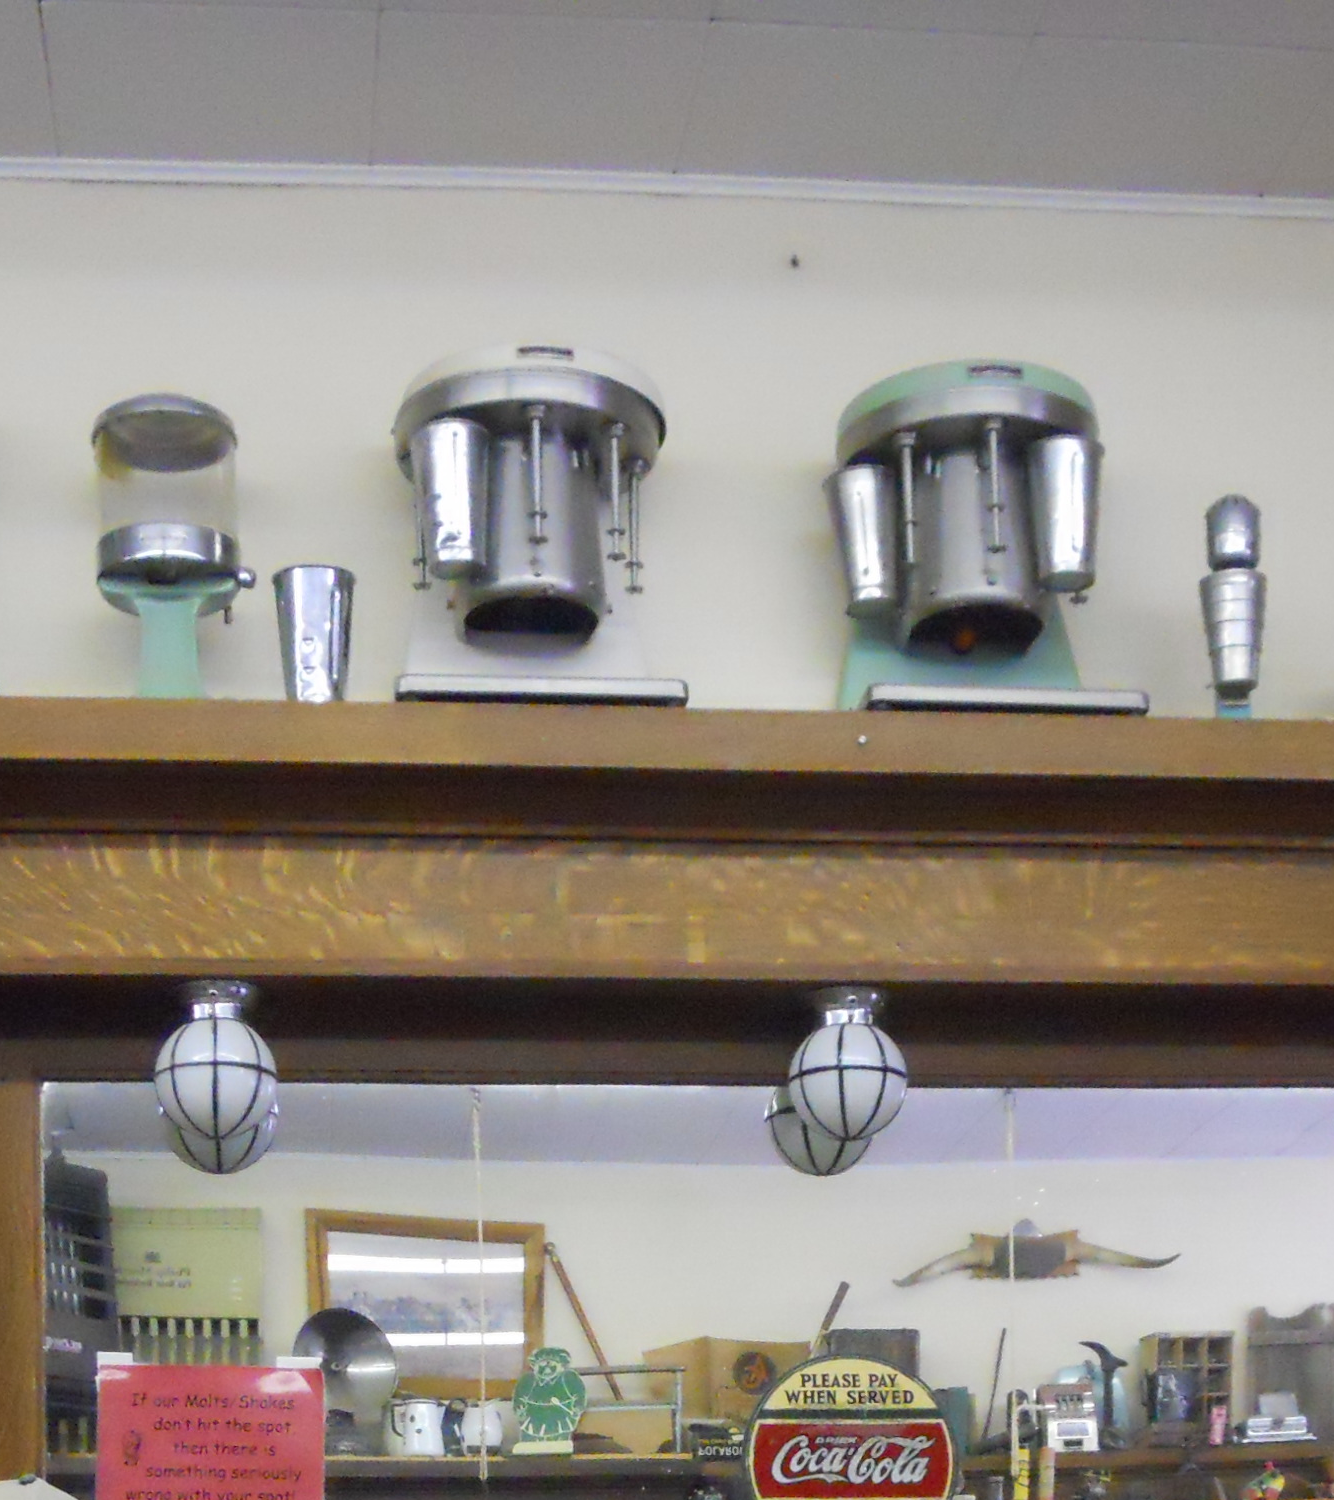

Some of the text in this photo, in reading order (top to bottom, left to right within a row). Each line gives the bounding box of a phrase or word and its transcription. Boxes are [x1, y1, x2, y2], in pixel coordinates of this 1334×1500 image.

[800, 1373, 899, 1389] PLEASE PAY
[131, 1392, 147, 1407] If
[153, 1398, 180, 1408] our
[784, 1389, 915, 1405] WHEN SERVED
[153, 1417, 192, 1431] don't
[197, 1417, 220, 1431] hit
[225, 1418, 252, 1432] the
[173, 1441, 277, 1457] then there is
[771, 1434, 937, 1485] Coca-Cola
[145, 1464, 302, 1482] something seriously
